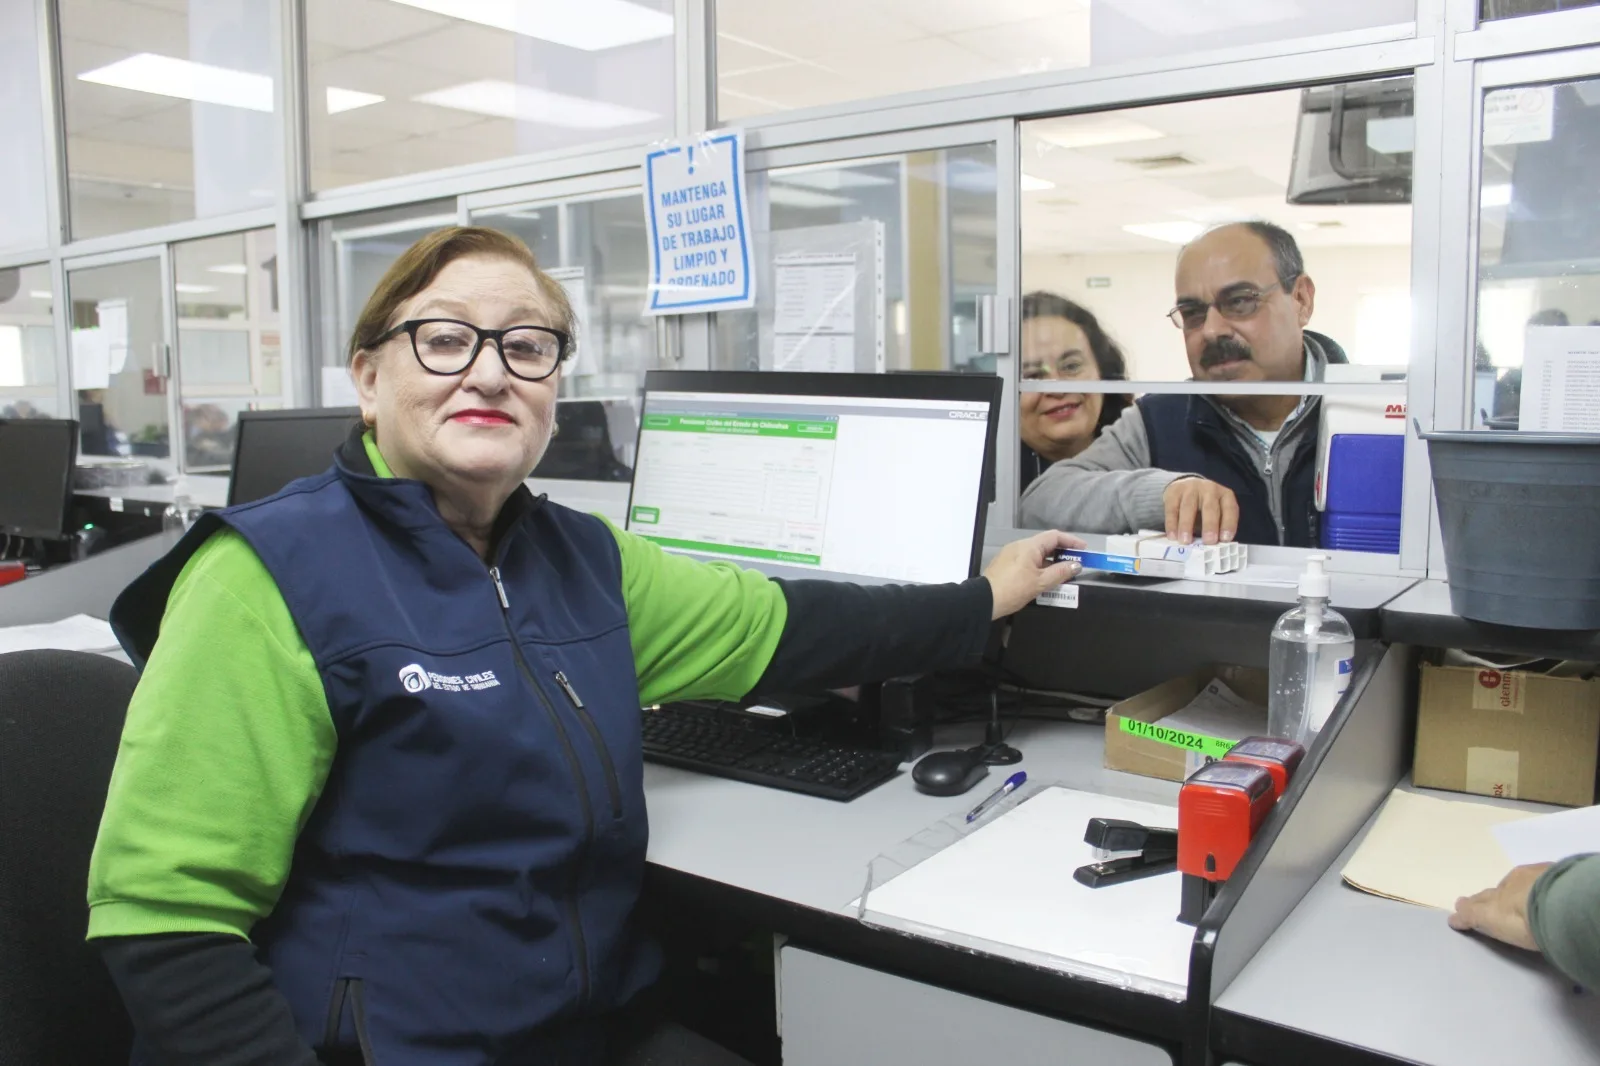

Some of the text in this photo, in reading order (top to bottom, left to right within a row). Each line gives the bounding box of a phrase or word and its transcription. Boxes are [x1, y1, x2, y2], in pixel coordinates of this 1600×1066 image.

[661, 181, 727, 207] MANTENGA
[667, 204, 725, 228] SU LUGAR
[662, 225, 736, 251] DE TRABAJO
[673, 248, 728, 271] LIMPIO Y
[949, 411, 987, 420] ORACLE
[1058, 554, 1081, 562] APOTEX
[1128, 719, 1204, 749] 01/10/2024
